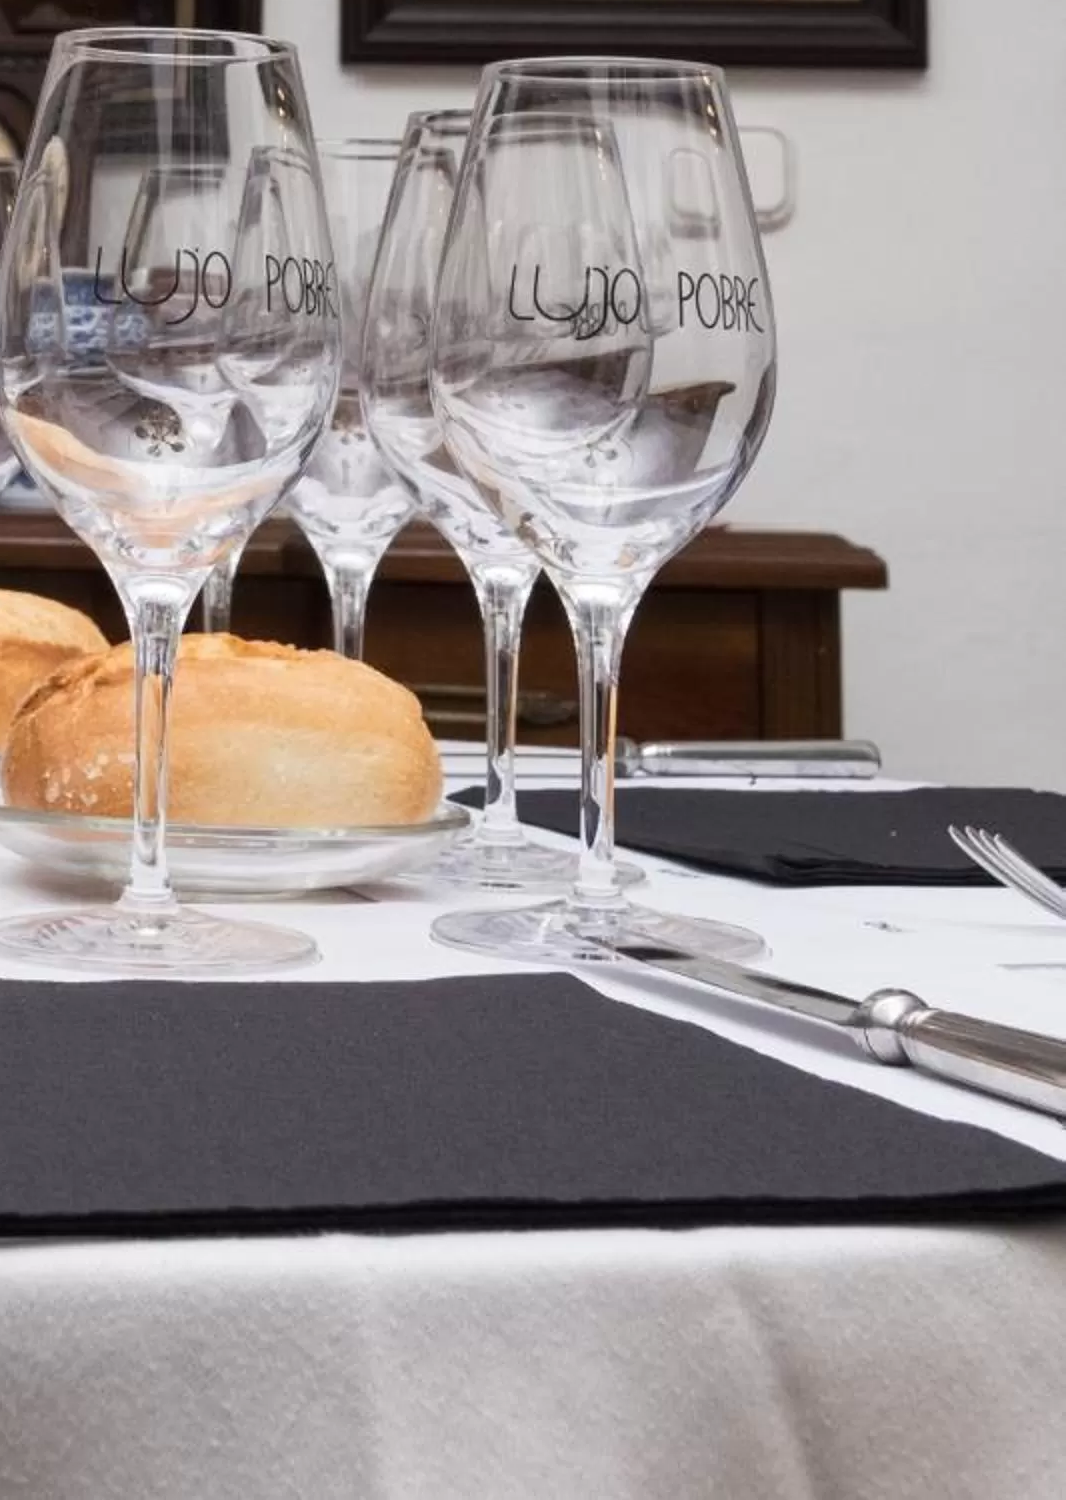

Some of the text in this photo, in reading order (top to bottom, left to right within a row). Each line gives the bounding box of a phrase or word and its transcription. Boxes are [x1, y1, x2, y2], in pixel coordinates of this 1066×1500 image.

[94, 245, 339, 325] LUJO POBRE
[509, 264, 641, 340] LUJO
[677, 271, 765, 333] POBRE
